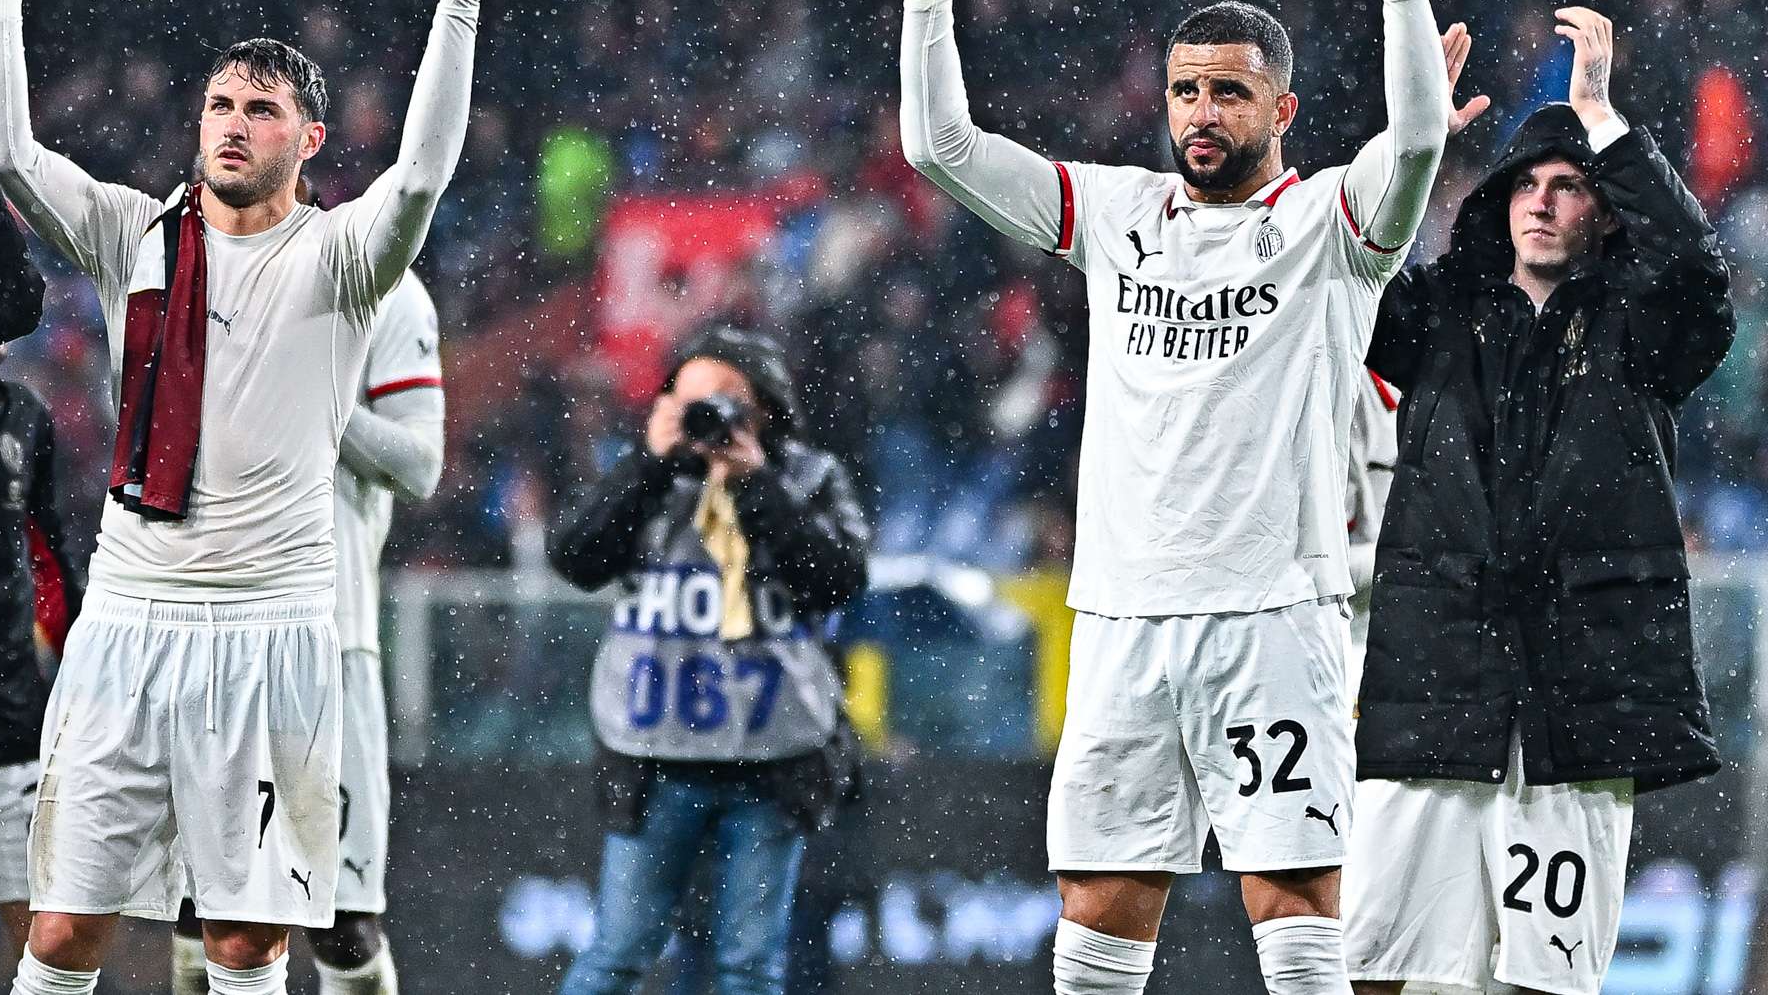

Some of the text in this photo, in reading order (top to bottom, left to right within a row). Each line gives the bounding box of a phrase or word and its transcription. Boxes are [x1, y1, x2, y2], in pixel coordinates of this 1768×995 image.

[1117, 272, 1279, 321] Emirates
[1127, 323, 1249, 360] FLY BETTER
[629, 656, 782, 732] 067
[1226, 719, 1312, 797] 32
[1503, 843, 1586, 918] 20
